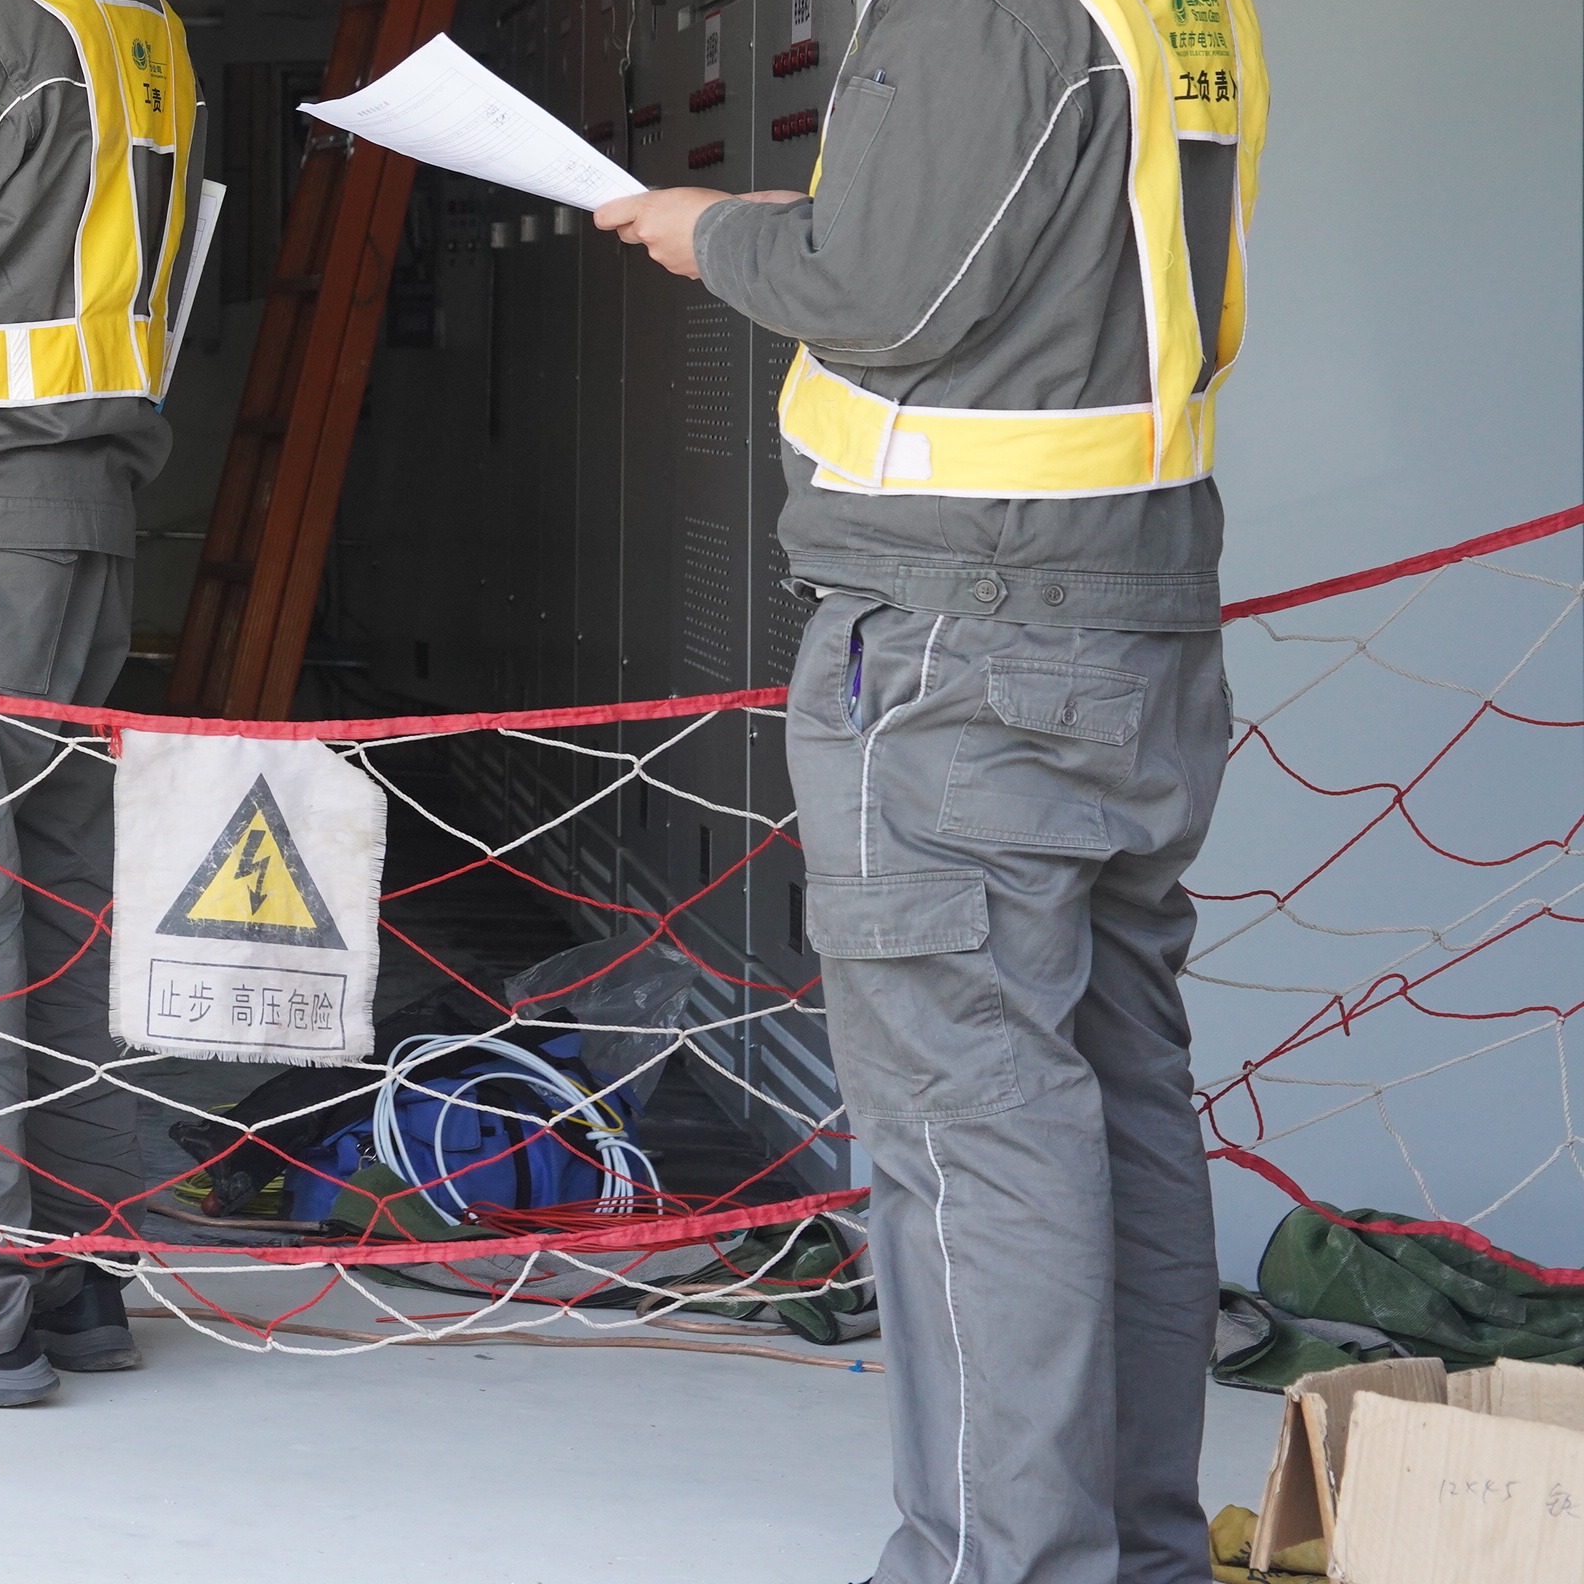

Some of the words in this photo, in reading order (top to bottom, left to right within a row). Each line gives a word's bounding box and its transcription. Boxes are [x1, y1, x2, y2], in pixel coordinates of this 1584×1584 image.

[157, 979, 215, 1022] 止步
[231, 983, 334, 1031] 高压危险
